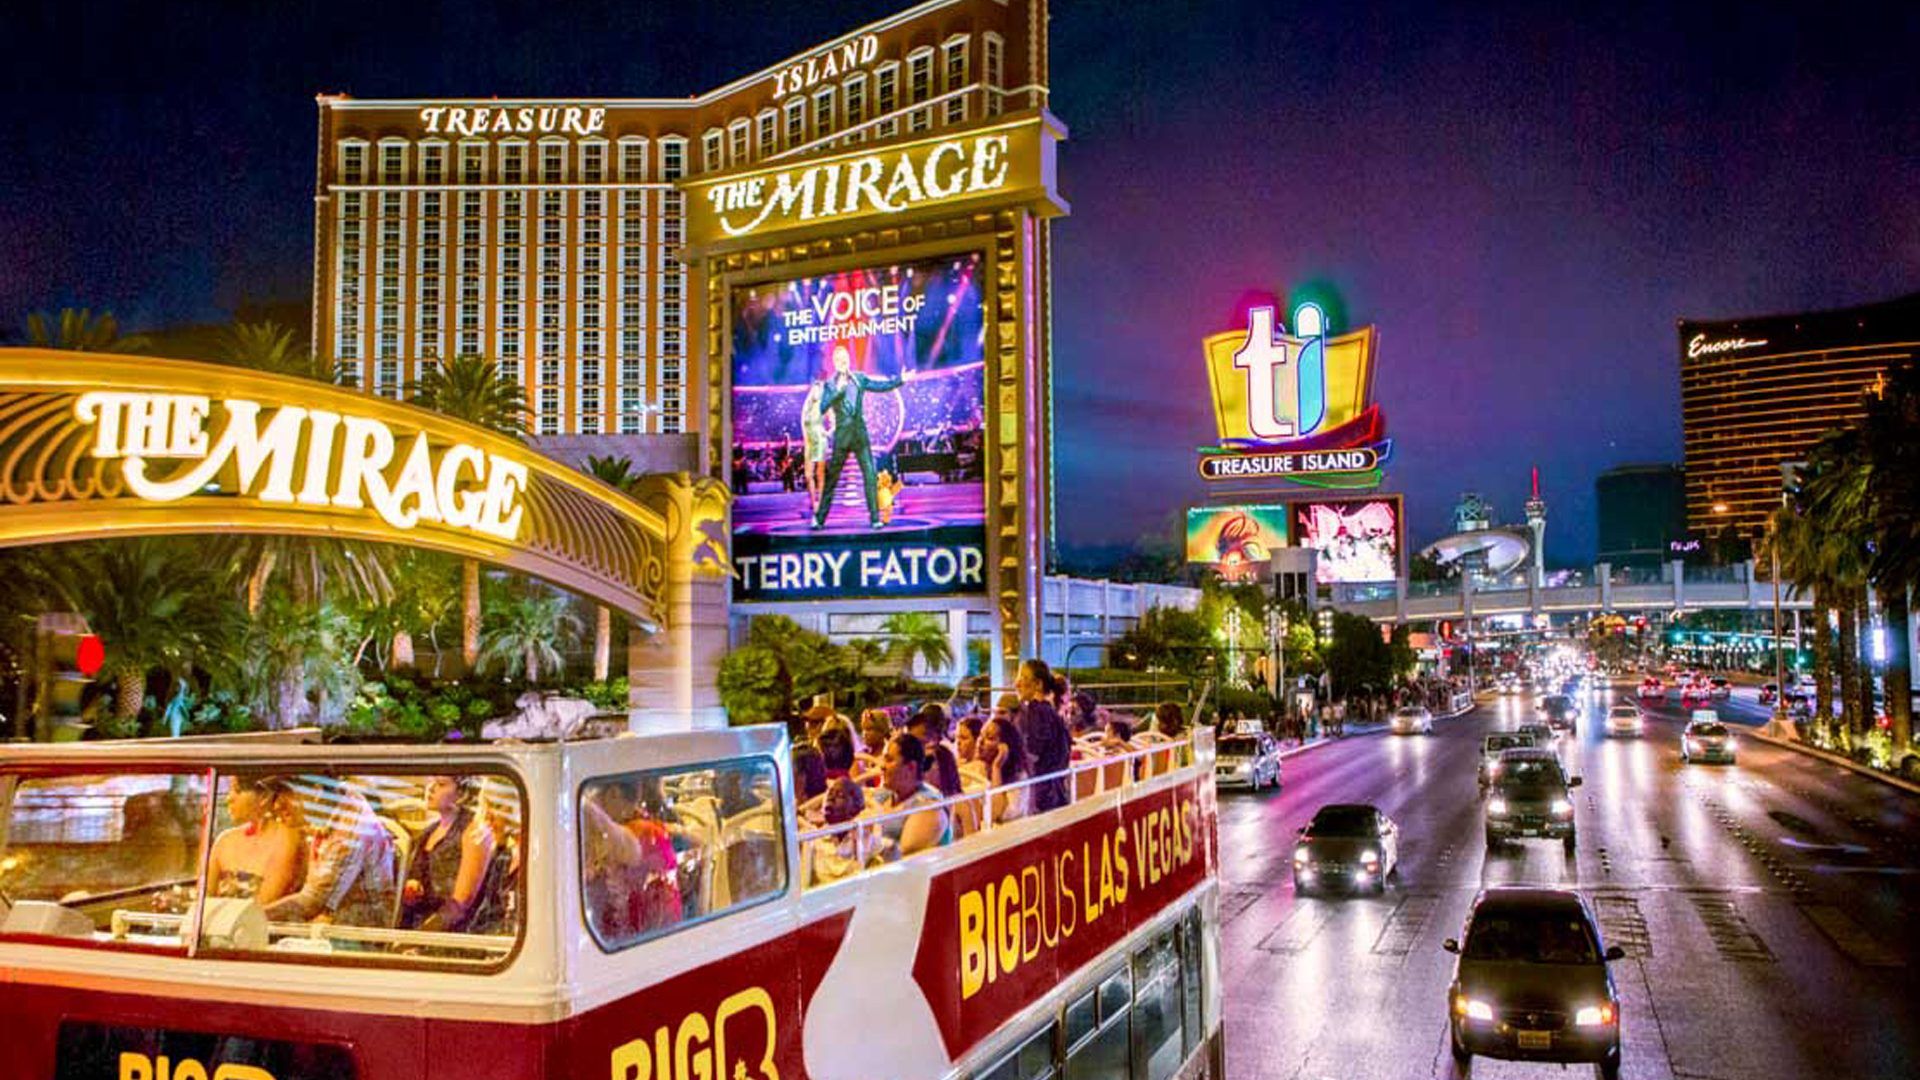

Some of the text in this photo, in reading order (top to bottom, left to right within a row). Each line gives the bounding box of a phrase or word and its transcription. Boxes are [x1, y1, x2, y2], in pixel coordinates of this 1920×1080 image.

[420, 34, 878, 136] TREASURE ISLAND
[707, 135, 1008, 236] THE MIRAGE
[783, 285, 926, 327] THE VOICE OF
[789, 315, 918, 346] ENTERTAINMENT
[1688, 333, 1768, 358] Encore
[74, 391, 527, 540] THE MIRAGE
[1212, 453, 1366, 475] TREASURE ISLAND
[736, 547, 983, 590] TERRY FATOR
[1083, 822, 1129, 923] LAS
[1133, 798, 1192, 890] VEGAS
